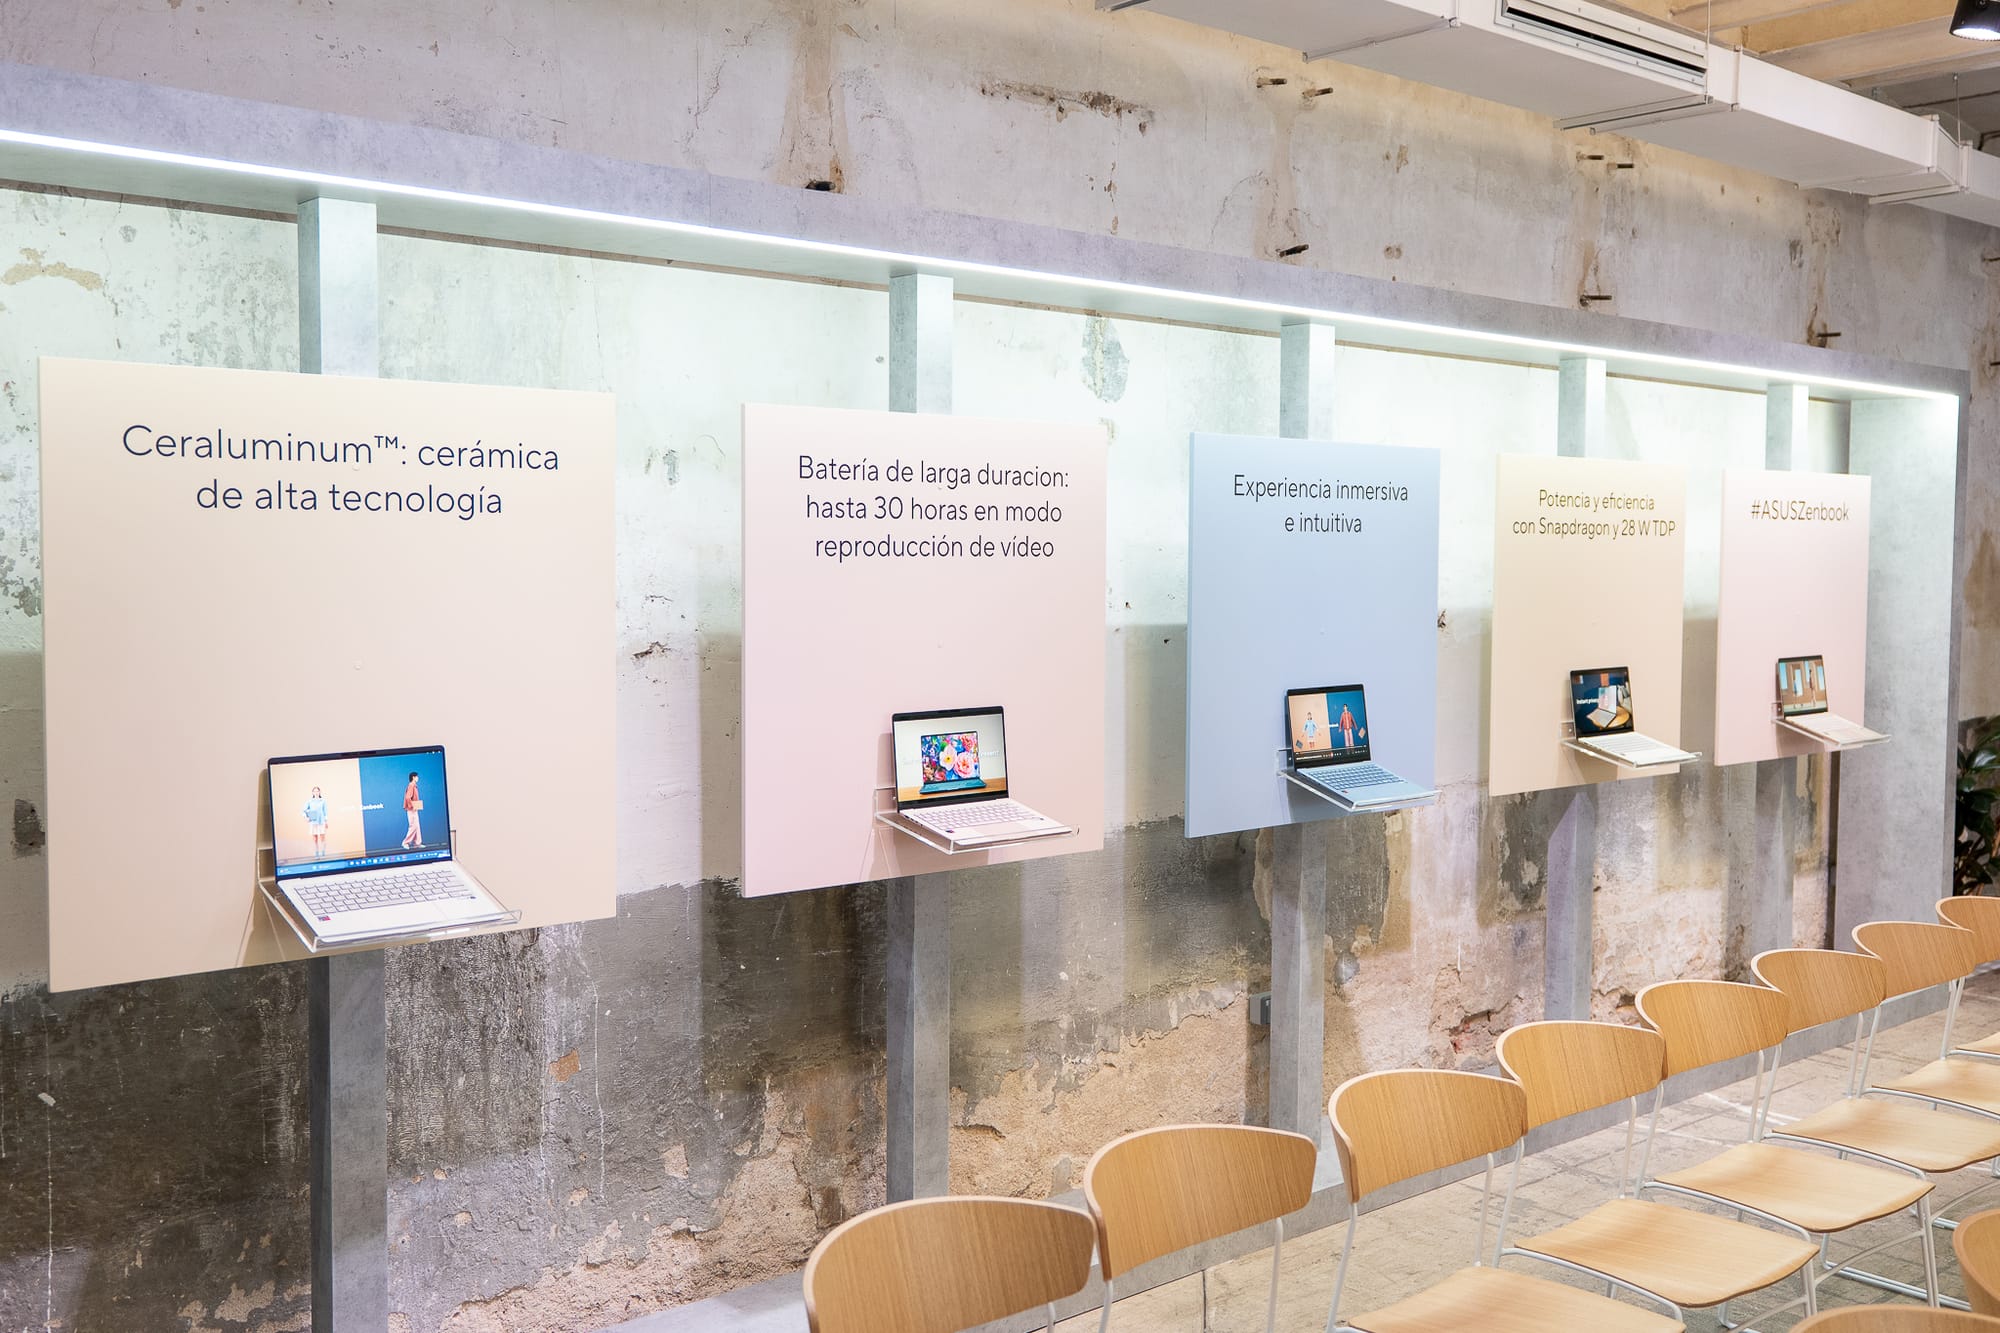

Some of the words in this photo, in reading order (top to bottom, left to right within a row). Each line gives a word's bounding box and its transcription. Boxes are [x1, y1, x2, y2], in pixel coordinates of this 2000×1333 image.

[417, 439, 559, 471] cerámica
[798, 454, 879, 483] Batería
[885, 458, 914, 484] de
[920, 460, 971, 491] larga
[977, 462, 1069, 488] duracion:
[196, 478, 243, 510] de
[255, 479, 318, 511] alta
[327, 483, 502, 521] tecnología
[1233, 473, 1332, 503] Experiencia
[1336, 479, 1409, 502] inmersiva
[1538, 488, 1591, 509] Potencia
[1593, 496, 1600, 513] y
[1602, 491, 1656, 511] eficiencia
[806, 493, 867, 520] hasta
[873, 495, 904, 520] 30
[911, 496, 968, 522] horas
[973, 504, 999, 522] en
[1005, 500, 1063, 523] modo
[1284, 516, 1295, 533] e
[1299, 511, 1363, 534] intuitiva
[1751, 499, 1850, 521] #ASUSZenbook
[1512, 519, 1536, 535] con
[1538, 516, 1611, 541] Snapdragon
[1612, 523, 1620, 541] y
[1621, 518, 1637, 537] 28
[1638, 519, 1651, 536] W
[1652, 519, 1677, 537] TDP
[815, 533, 963, 564] reproducción
[969, 534, 996, 558] de
[1000, 535, 1055, 558] vídeo
